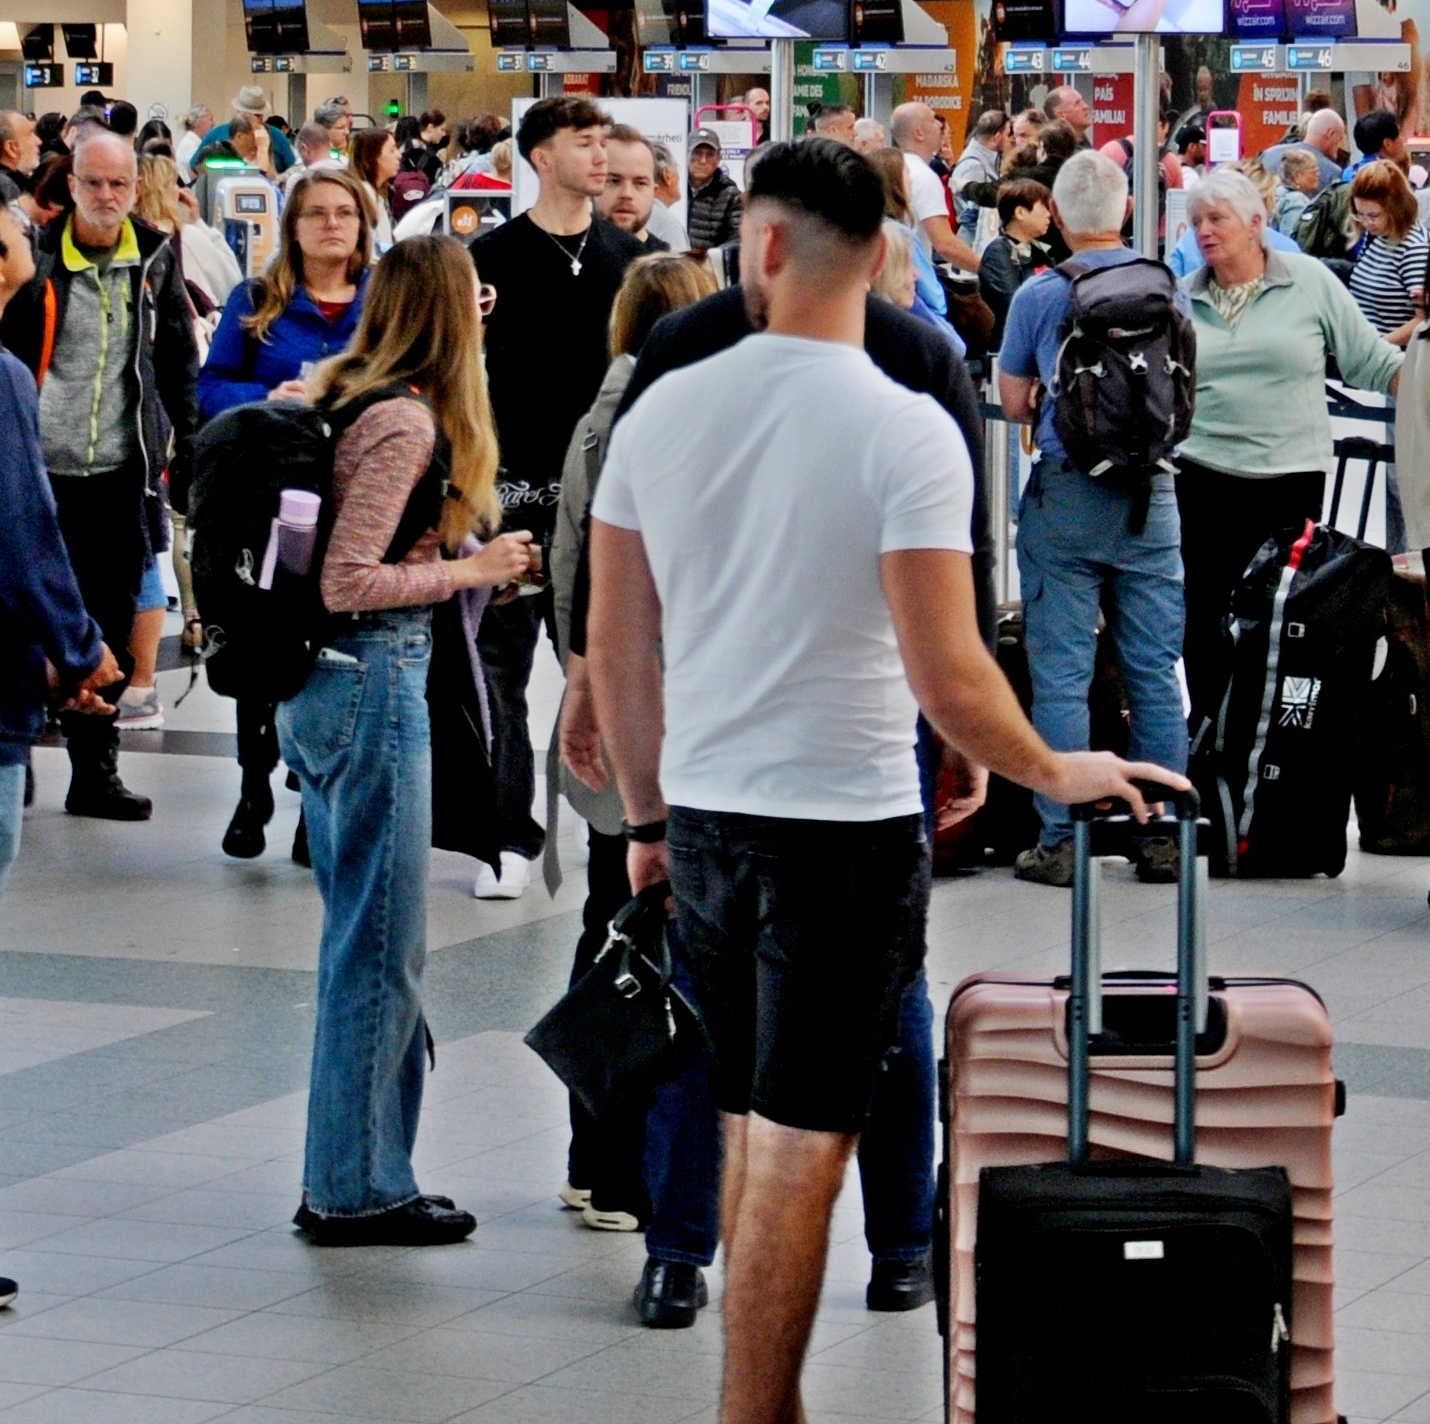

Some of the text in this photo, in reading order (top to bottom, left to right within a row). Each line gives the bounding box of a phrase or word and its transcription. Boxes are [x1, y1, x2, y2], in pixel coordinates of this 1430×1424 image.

[1237, 15, 1275, 27] wizzair.com
[1305, 13, 1345, 25] wizzair.com
[1031, 52, 1043, 70] 43
[1078, 49, 1091, 70] 44
[1261, 49, 1275, 67] 45
[1317, 49, 1332, 67] 46
[1094, 83, 1114, 101] PAÍS
